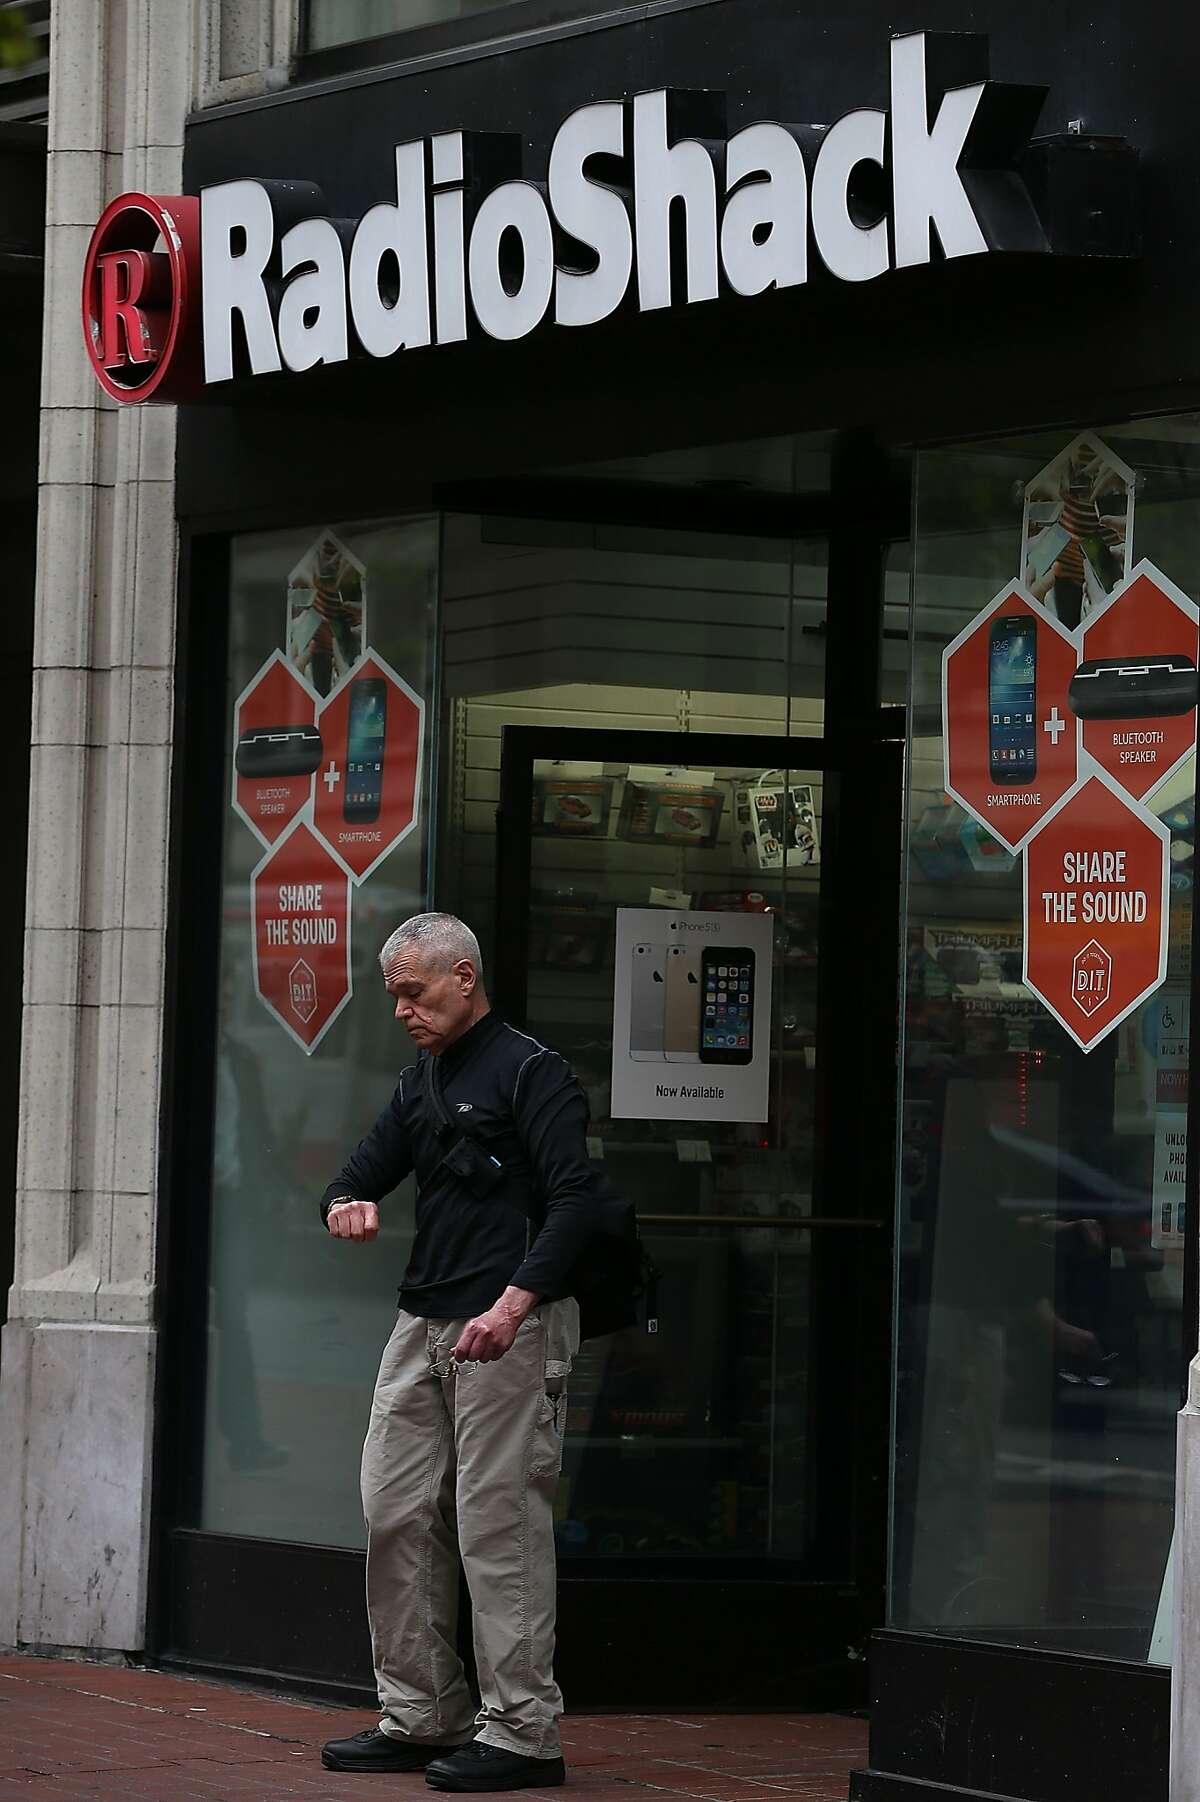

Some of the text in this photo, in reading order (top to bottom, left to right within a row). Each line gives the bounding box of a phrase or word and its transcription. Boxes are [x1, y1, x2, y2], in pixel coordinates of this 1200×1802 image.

[200, 31, 990, 386] RadioShack
[97, 249, 155, 369] R
[1113, 731, 1163, 745] BLUETOOTH
[1119, 751, 1157, 763] SPEAKER
[987, 793, 1041, 807] SMARTPHONE
[338, 831, 382, 842] SMARTPHONE
[1063, 851, 1127, 883] SHARE
[279, 884, 323, 912] SHARE
[1042, 891, 1147, 923] THE SOUND
[265, 918, 337, 945] THE SOUND
[656, 1085, 724, 1099] Now Available
[1165, 1133, 1188, 1146] UNLO
